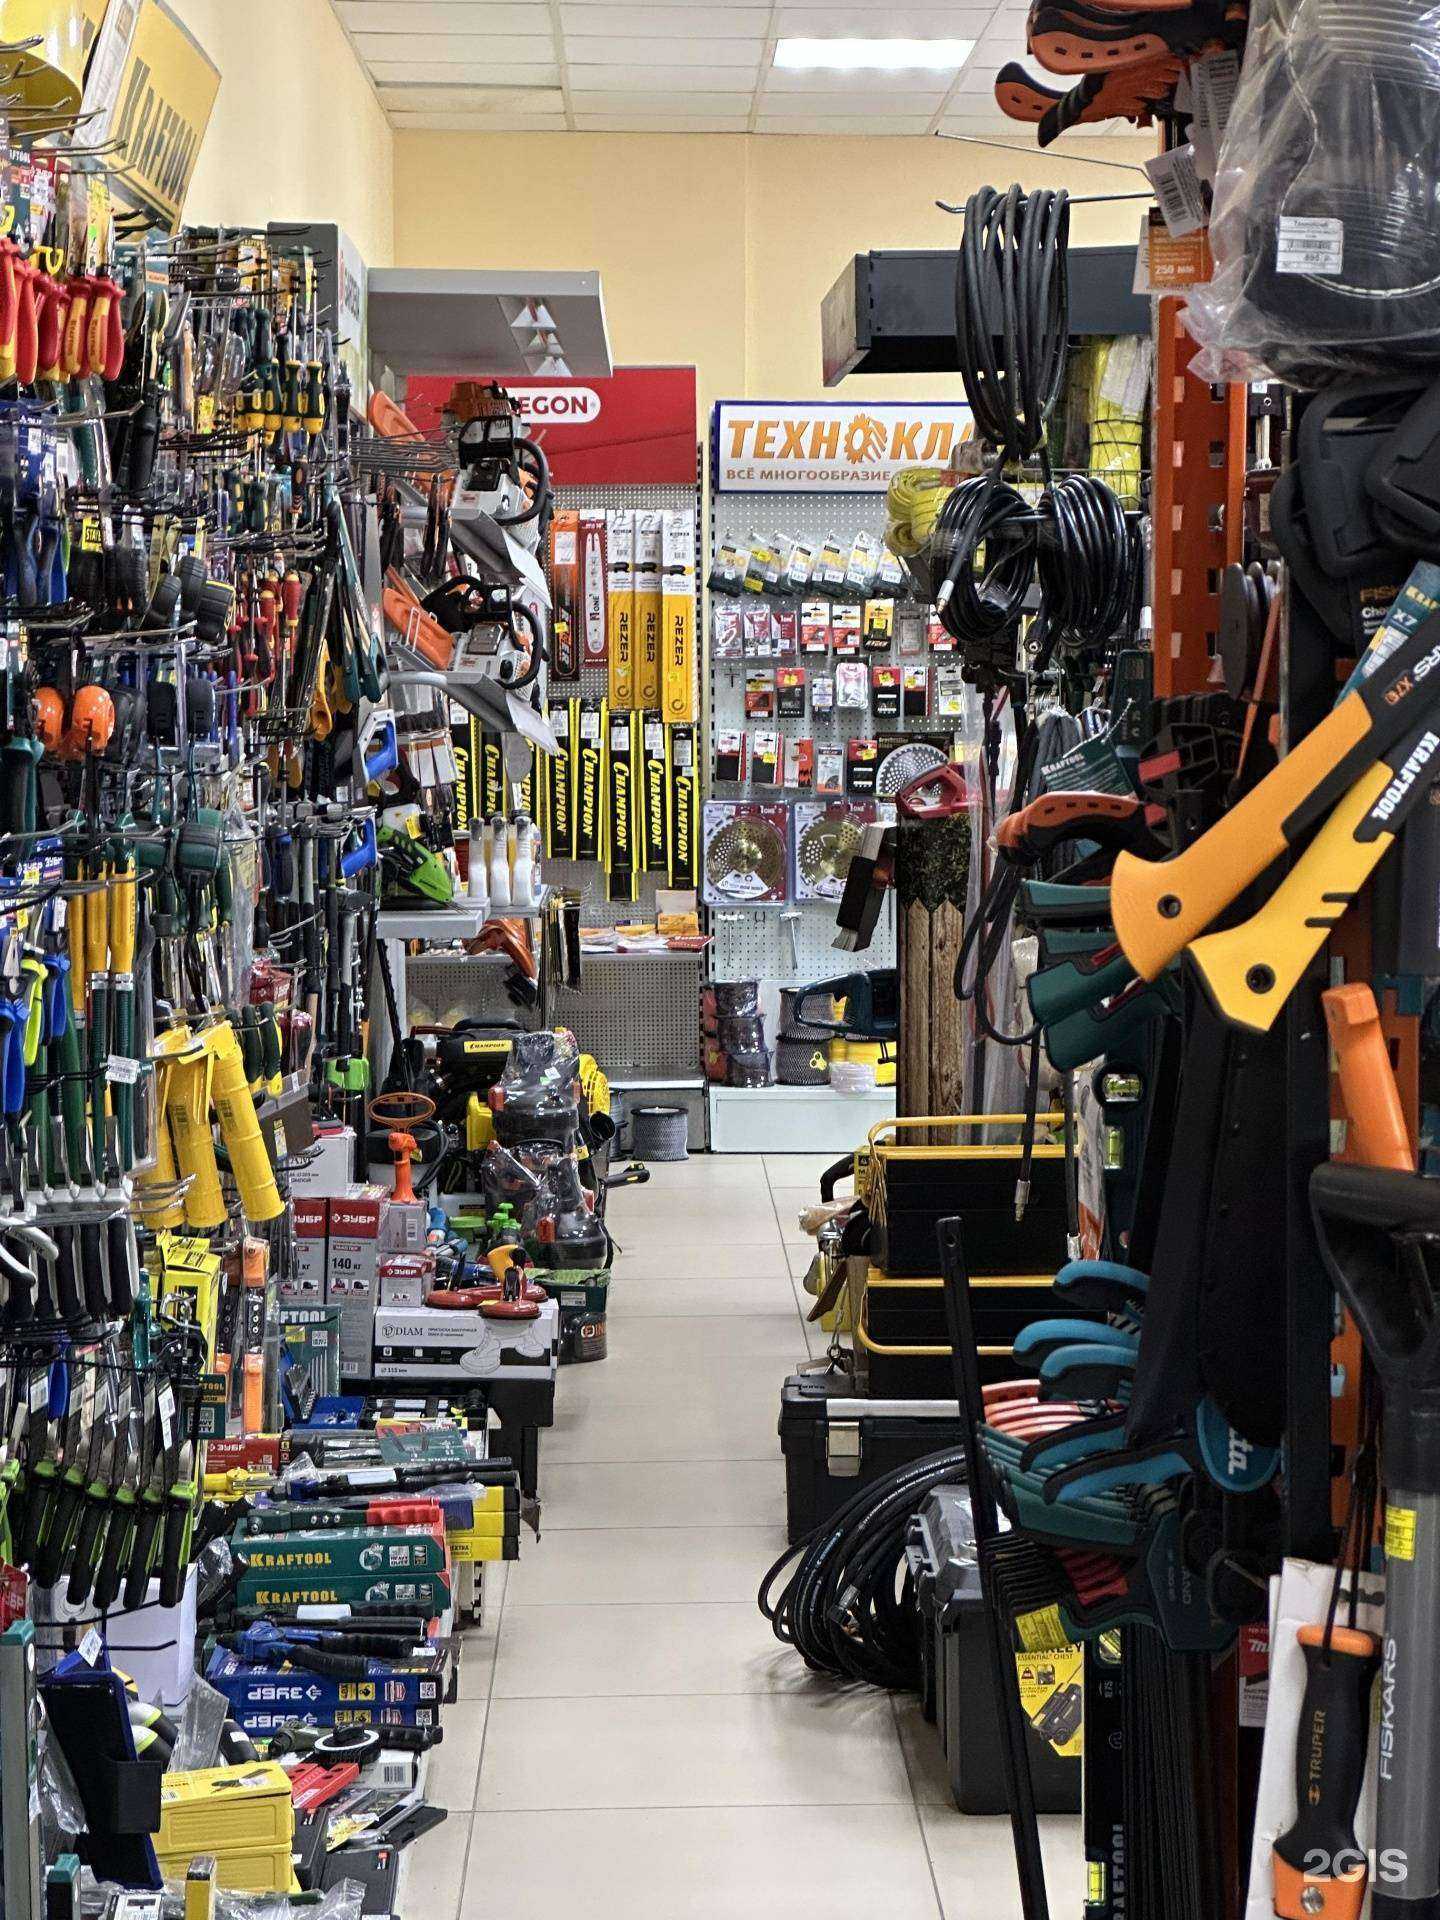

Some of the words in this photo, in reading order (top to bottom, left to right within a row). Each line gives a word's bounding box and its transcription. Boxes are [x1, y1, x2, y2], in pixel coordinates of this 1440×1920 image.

[114, 57, 198, 207] KRAFTOOL
[520, 396, 588, 415] EGON
[726, 466, 755, 480] ВСЁ
[759, 470, 890, 482] МНОГООБРАЗИЕ
[619, 612, 629, 664] REZER
[645, 612, 656, 664] REZER
[673, 615, 684, 668] REZER
[1393, 608, 1418, 626] X7
[485, 744, 500, 815] CHAMPI
[582, 748, 598, 839] CHAMPION
[1371, 731, 1440, 821] KRAFTOOL
[613, 761, 630, 851] CHAMPION
[647, 759, 664, 849] CHAMPION
[675, 775, 692, 866] CHAMPION
[342, 1214, 376, 1224] ЗУБР
[331, 1257, 352, 1270] 140
[280, 1311, 327, 1324] FTOOL
[395, 1327, 423, 1336] DIAM
[202, 1382, 224, 1391] TOOL
[250, 1552, 332, 1568] KRAFTOOL
[256, 1590, 338, 1605] KRAFTOOL
[247, 1686, 303, 1700] ЗУБР
[1380, 1638, 1397, 1780] FISKARS
[1309, 1710, 1326, 1780] TRUPER
